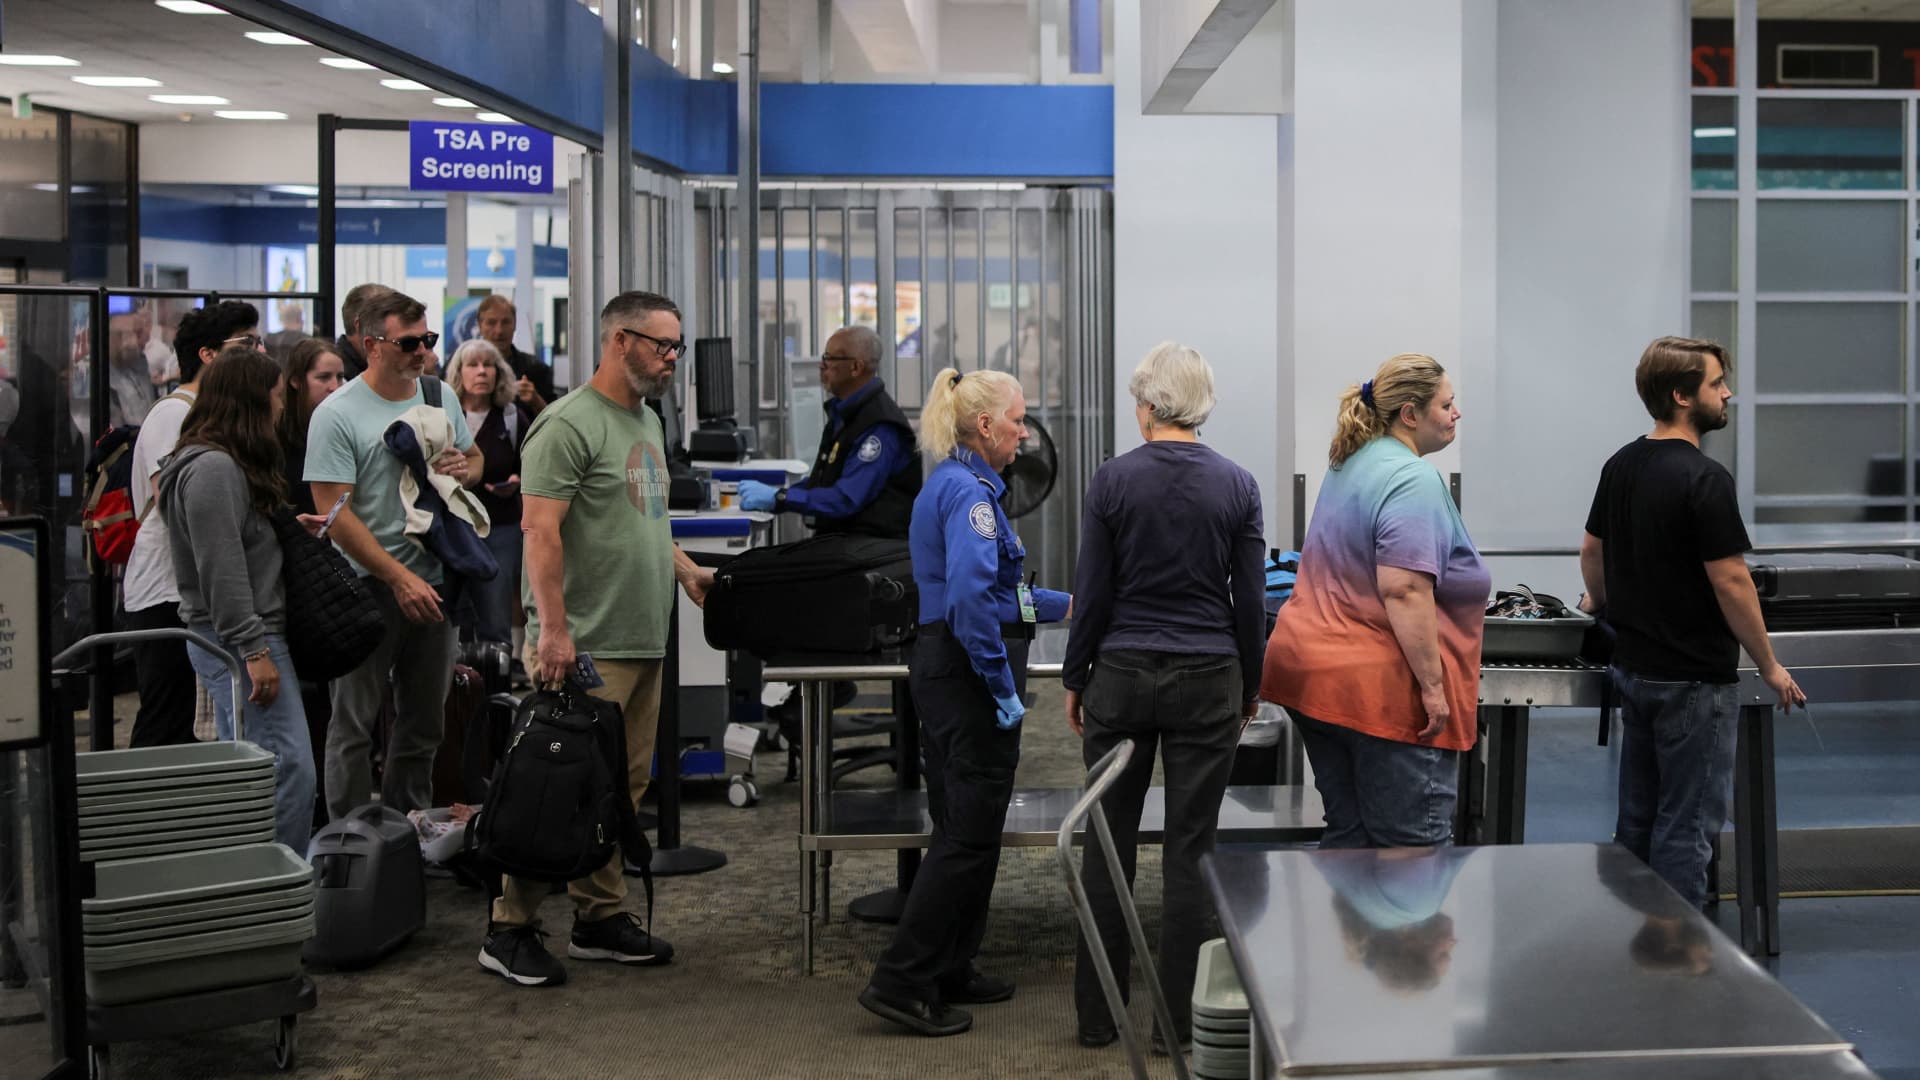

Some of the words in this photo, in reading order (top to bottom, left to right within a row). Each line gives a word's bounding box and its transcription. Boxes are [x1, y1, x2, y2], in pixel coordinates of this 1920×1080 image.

[434, 128, 485, 150] TSA
[491, 131, 530, 151] Pre
[422, 157, 543, 186] Screening
